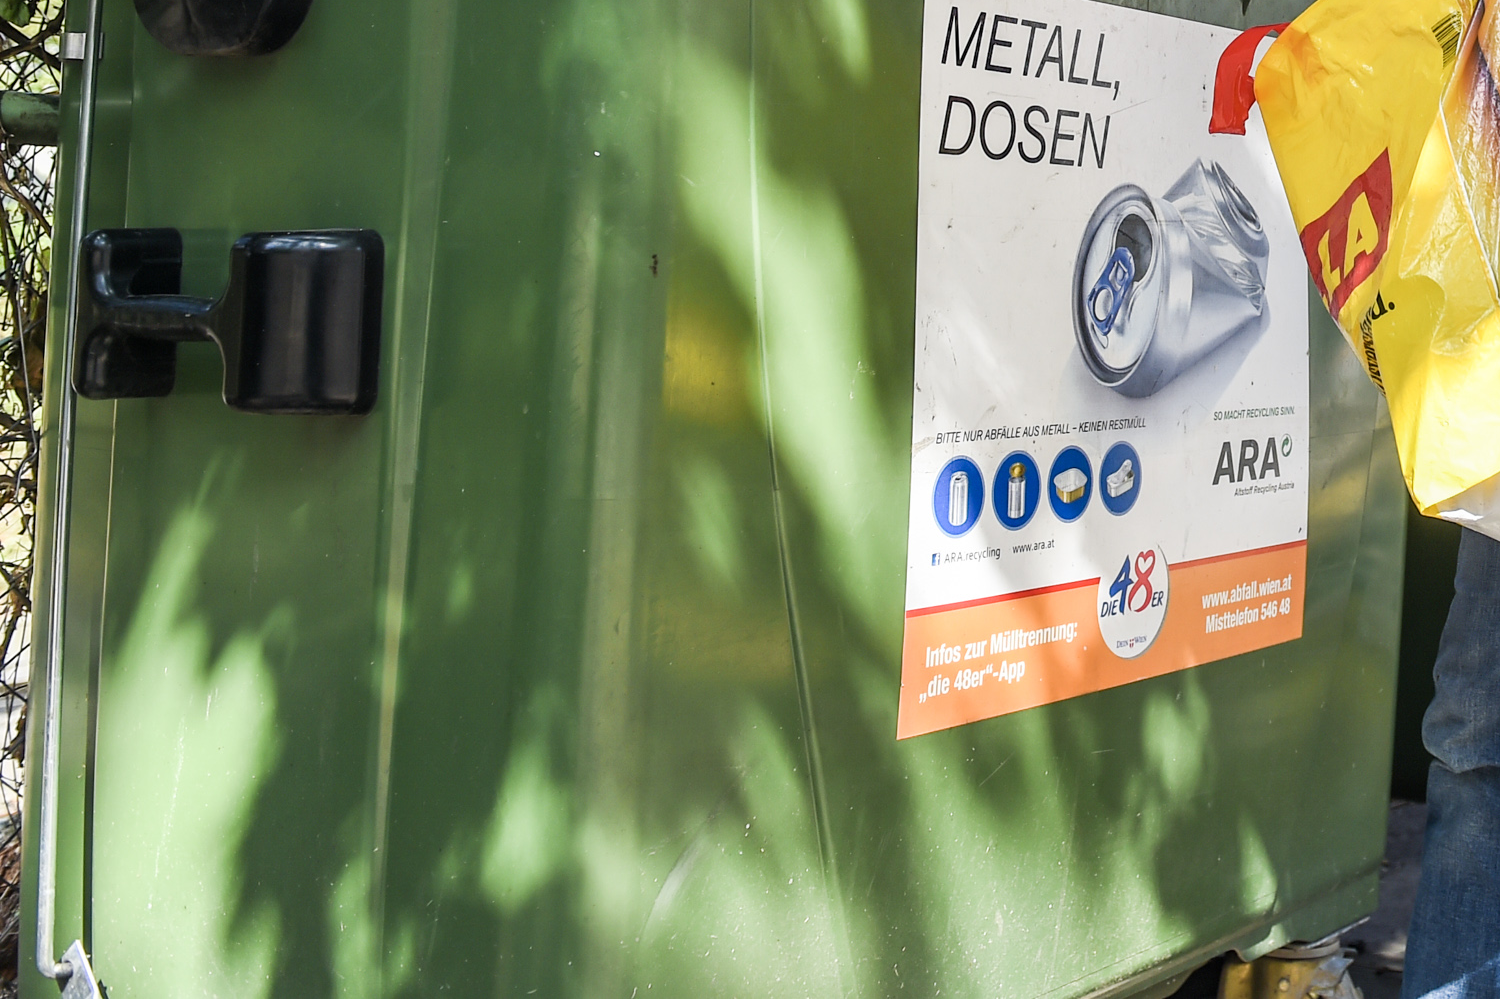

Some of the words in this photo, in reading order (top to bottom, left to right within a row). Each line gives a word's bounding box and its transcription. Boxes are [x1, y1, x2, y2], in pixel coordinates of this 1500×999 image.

[941, 6, 1120, 101] METALL,
[938, 94, 1110, 169] DOSEN
[1318, 191, 1379, 308] LA
[936, 431, 961, 444] BITTE
[963, 429, 983, 443] NUR
[984, 426, 1022, 441] ABFÄLLE
[1022, 425, 1040, 438] AUS
[1041, 423, 1070, 436] METALL
[1079, 420, 1108, 433] KEINEN
[1109, 417, 1146, 431] RESTMÜLL
[1213, 411, 1223, 421] SO
[1223, 409, 1246, 420] MACHT
[1246, 407, 1280, 419] RECYCLING
[1212, 437, 1280, 485] ARA
[1234, 486, 1253, 496] Altstoff
[1253, 484, 1277, 495] Recycling
[1278, 481, 1295, 490] Austria
[944, 547, 1001, 563] ARA.recycling
[1012, 539, 1055, 554] www.ara.at
[1202, 573, 1292, 609] www.abfall.wien.at
[1205, 606, 1259, 634] Misttelefon
[1260, 600, 1278, 620] 546
[1279, 597, 1291, 615] 48
[925, 643, 961, 668] Infos
[964, 640, 987, 660] zur
[990, 622, 1078, 655] Mülltrennung:
